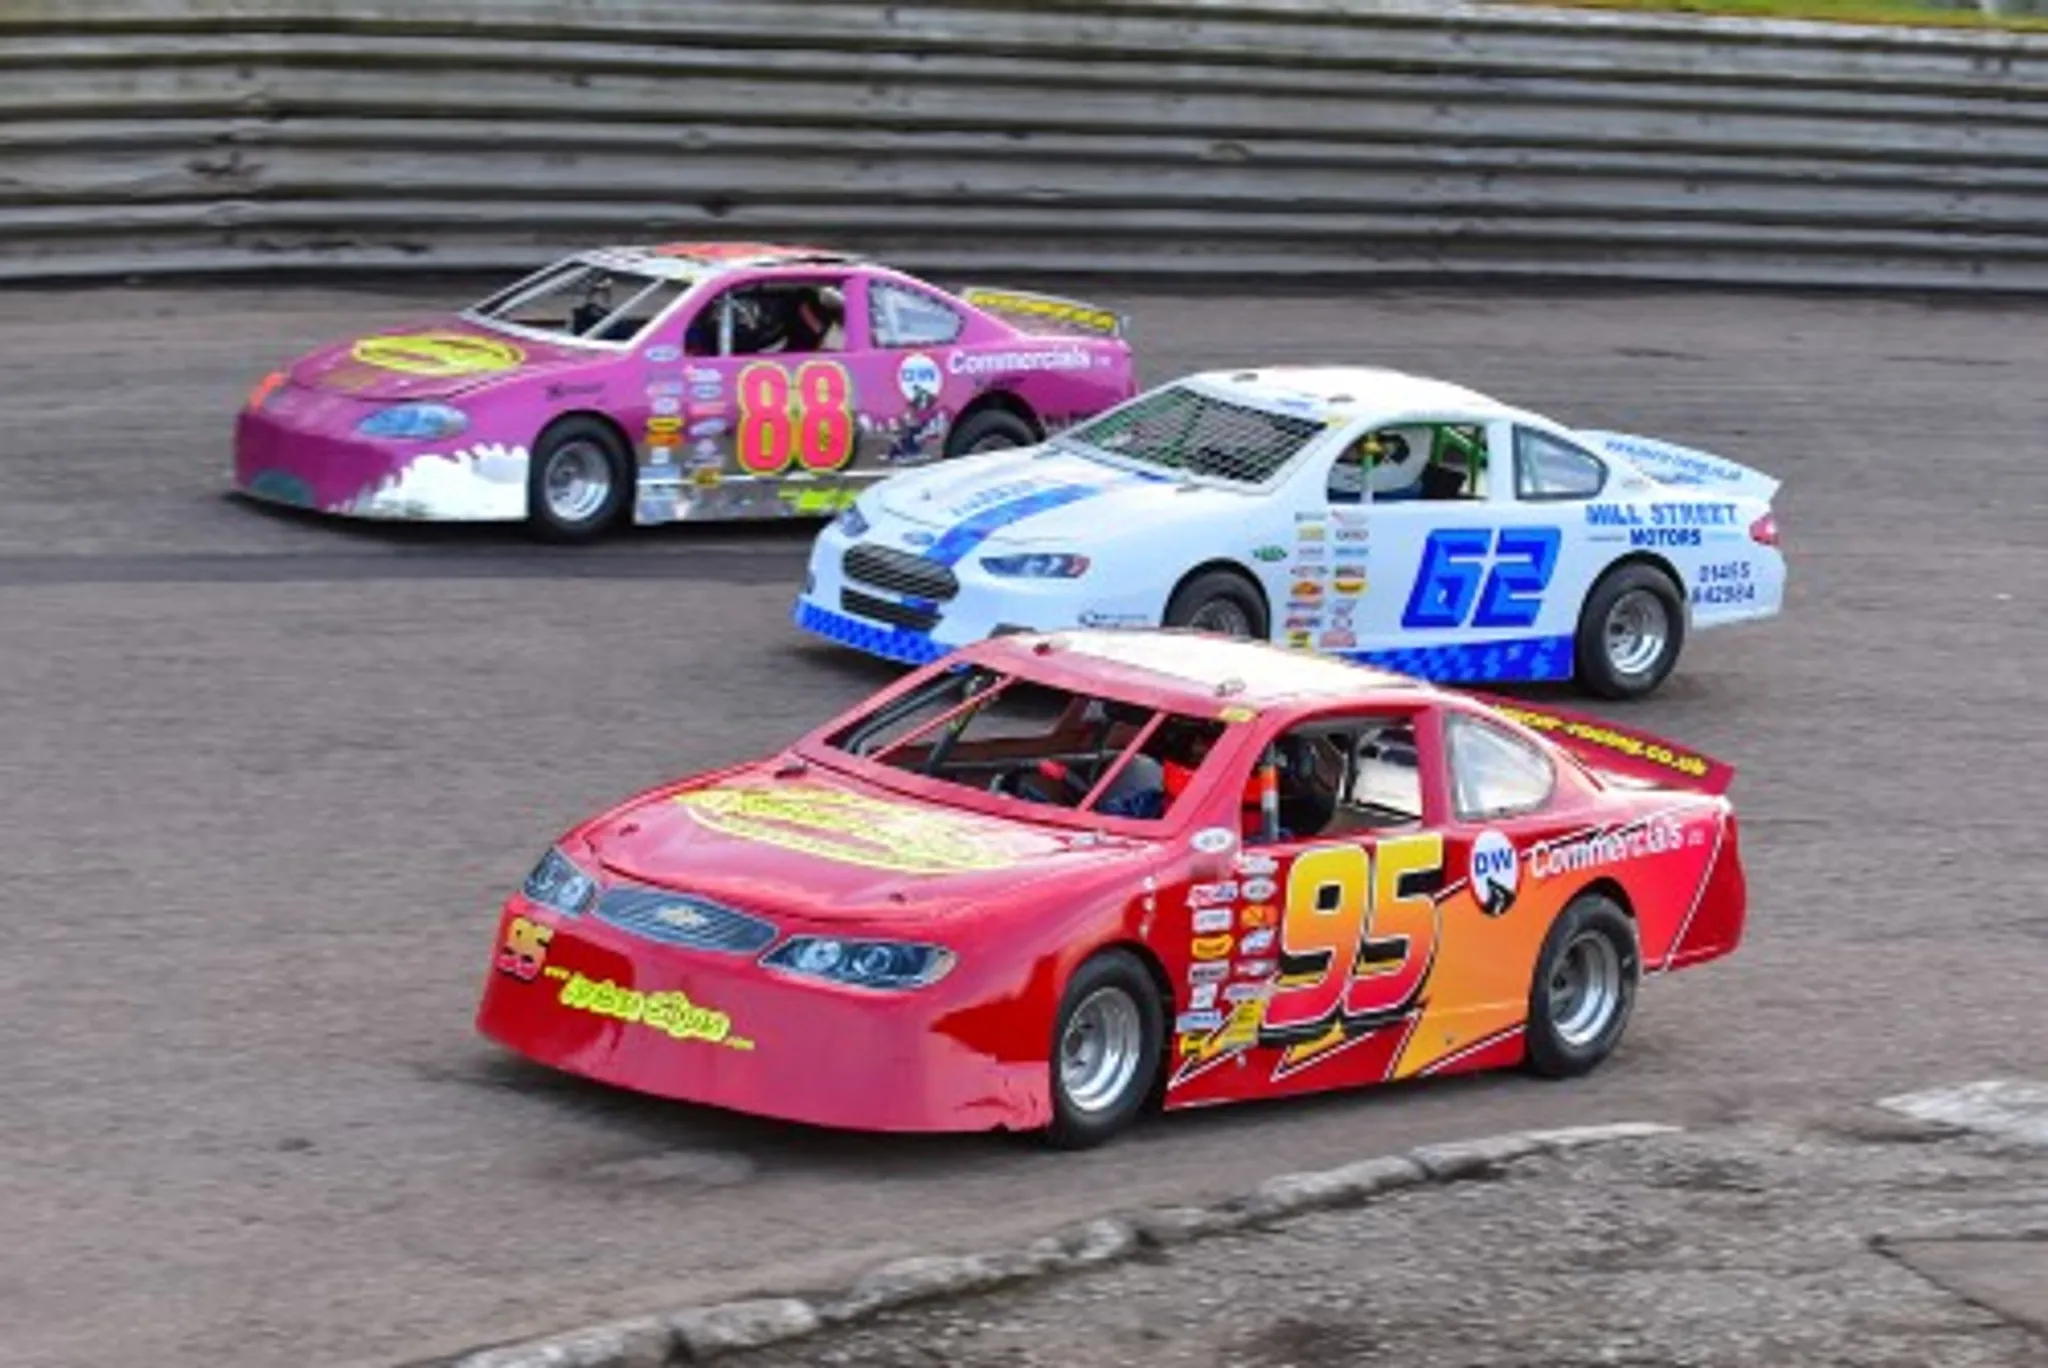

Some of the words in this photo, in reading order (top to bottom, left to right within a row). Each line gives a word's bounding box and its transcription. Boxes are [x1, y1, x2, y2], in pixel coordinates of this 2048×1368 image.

[949, 346, 1091, 375] Commercials
[737, 360, 852, 476] 88
[1585, 503, 1642, 525] MILL
[1650, 503, 1737, 525] STREET
[1630, 528, 1701, 546] MOTORS
[1401, 526, 1562, 629] 62
[1475, 848, 1513, 875] DW
[1530, 816, 1684, 878] Commercials
[498, 916, 555, 981] 95
[1261, 832, 1443, 1032] 95
